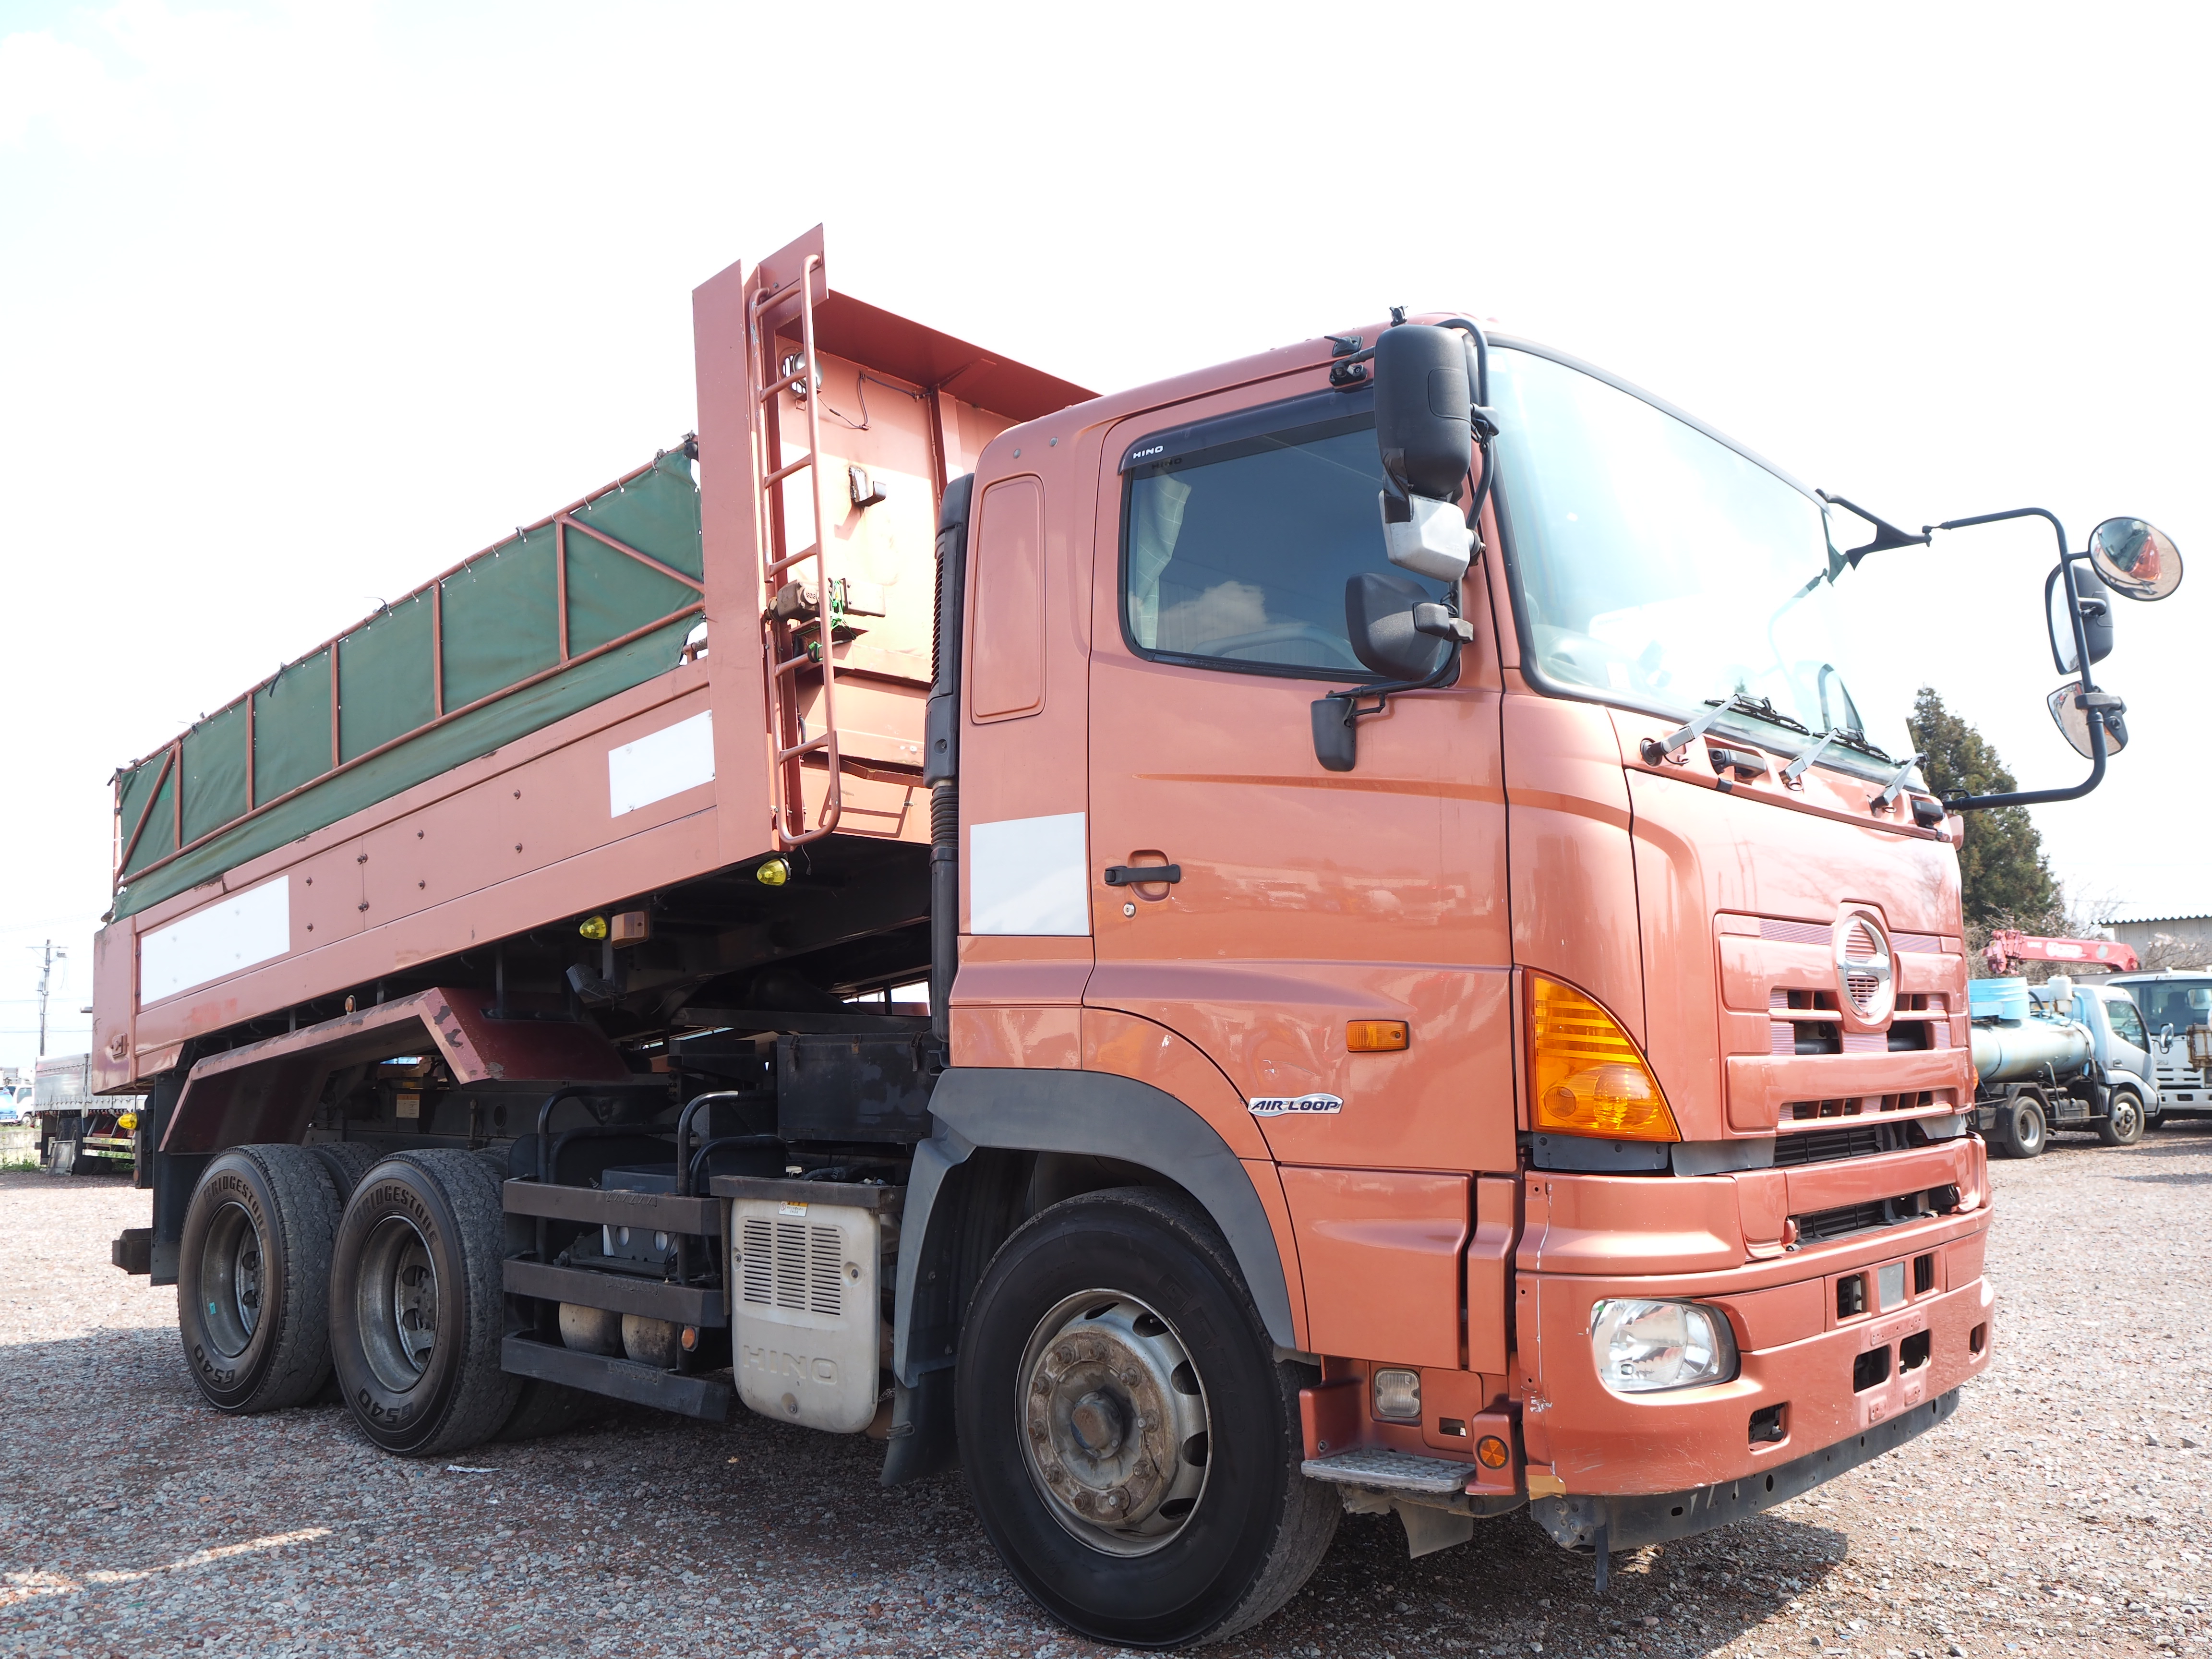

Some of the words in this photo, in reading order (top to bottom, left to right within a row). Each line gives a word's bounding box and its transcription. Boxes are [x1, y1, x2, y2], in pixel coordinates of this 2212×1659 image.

[1133, 445, 1164, 459] HINO
[1251, 1101, 1283, 1110] AIR
[1288, 1101, 1338, 1111] LOOP
[203, 1175, 267, 1241] BRIDGESTONE
[353, 1184, 438, 1246] BRIDGESTONE
[194, 1344, 235, 1385] G540
[744, 1345, 838, 1385] HINO
[358, 1388, 413, 1425] G540
